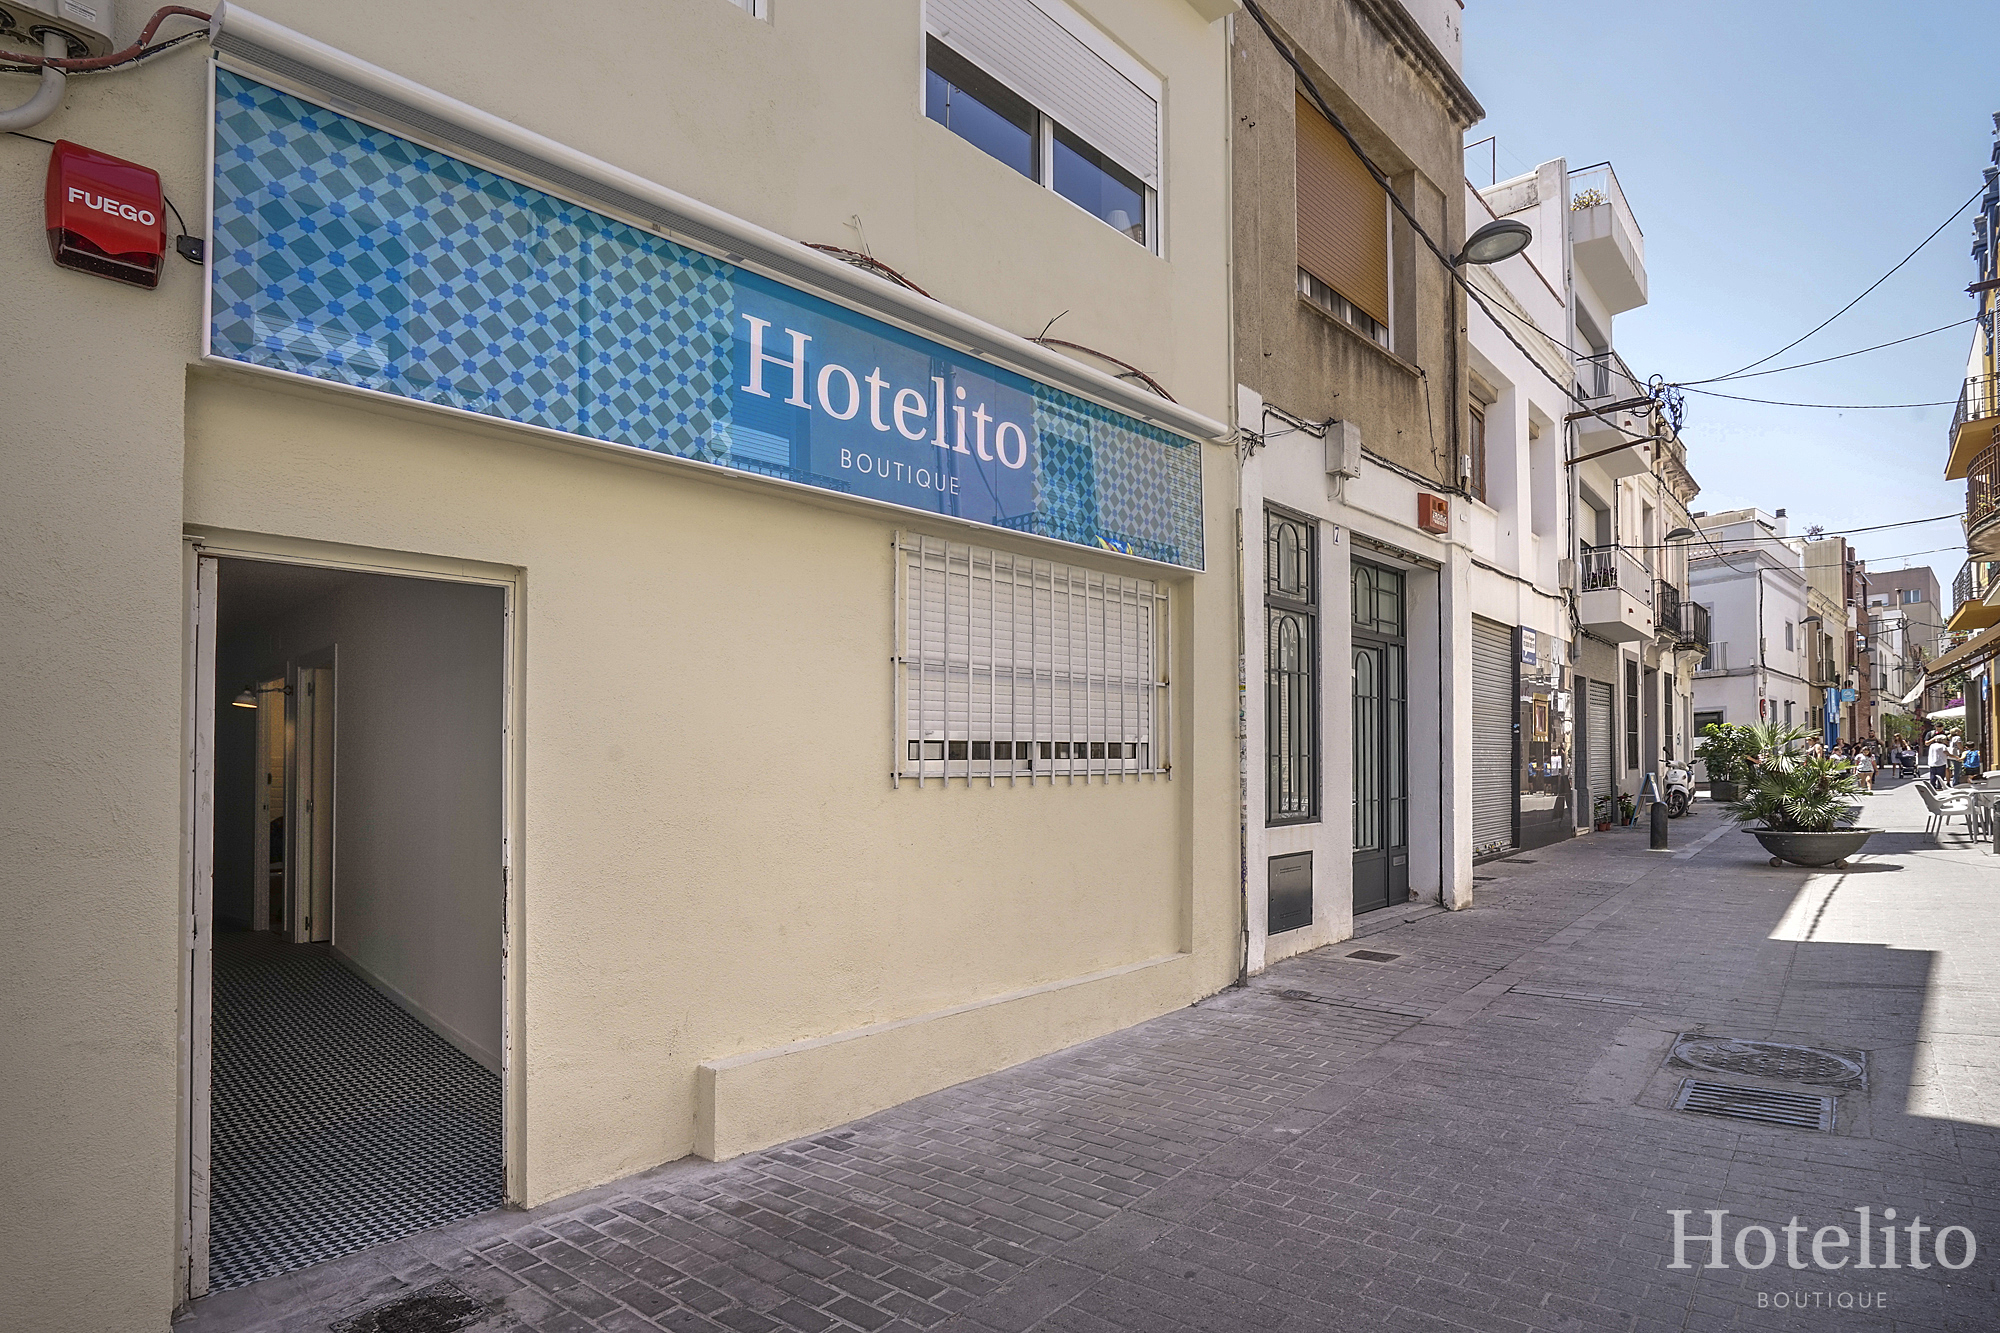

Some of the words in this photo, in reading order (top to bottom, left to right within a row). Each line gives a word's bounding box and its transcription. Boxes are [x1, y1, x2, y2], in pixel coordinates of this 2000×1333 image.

[68, 187, 155, 226] FUEGO
[741, 313, 1028, 470] Hotelito
[840, 448, 961, 496] BOUTIQUE
